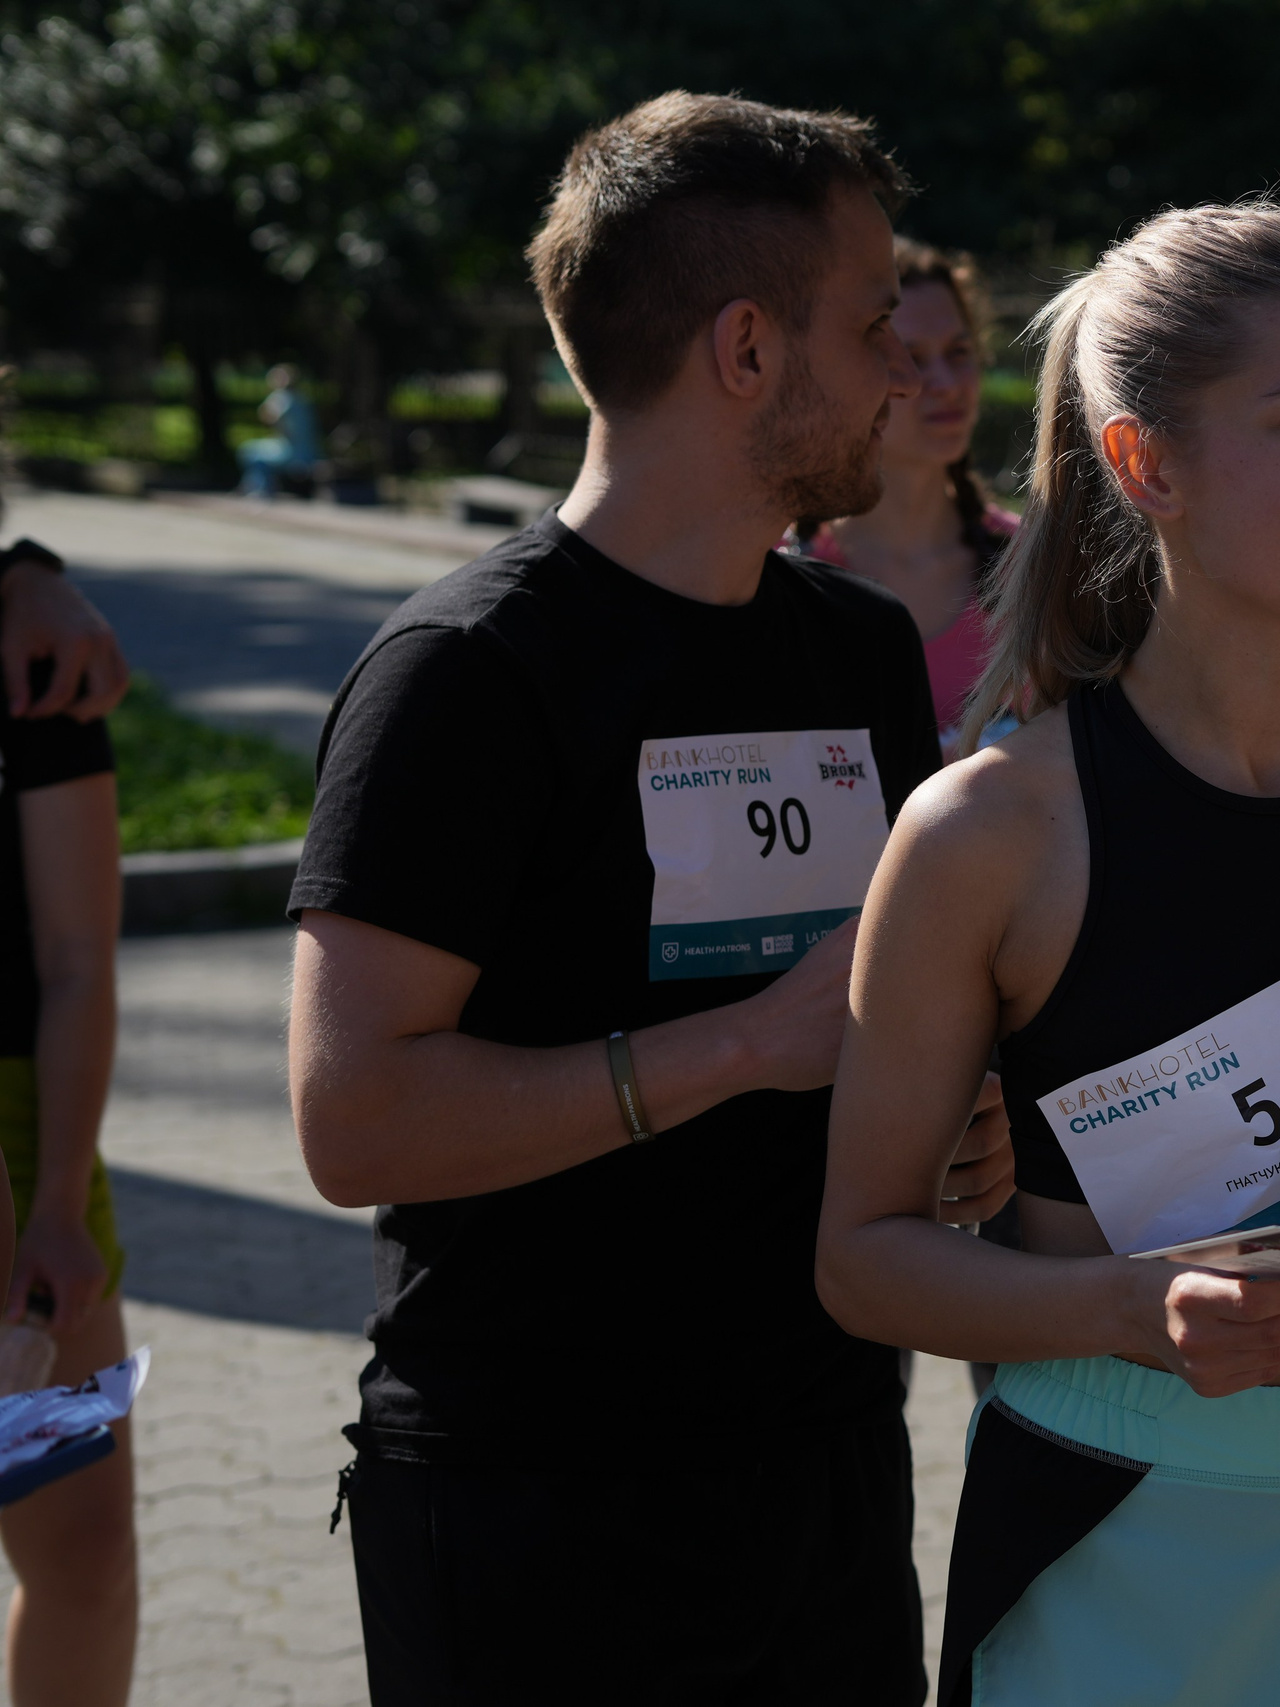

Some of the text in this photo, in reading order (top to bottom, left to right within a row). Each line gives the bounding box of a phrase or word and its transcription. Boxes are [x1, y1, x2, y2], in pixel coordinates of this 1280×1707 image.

[646, 744, 767, 770] BANKHOTEL
[651, 768, 772, 791] CHARITY RUN
[818, 762, 867, 781] BRONX
[747, 797, 811, 859] 90
[684, 943, 751, 956] HEALTH PATRONS
[1057, 1033, 1230, 1116] BANKHOTEL
[1069, 1051, 1241, 1134] CHARITY RUN
